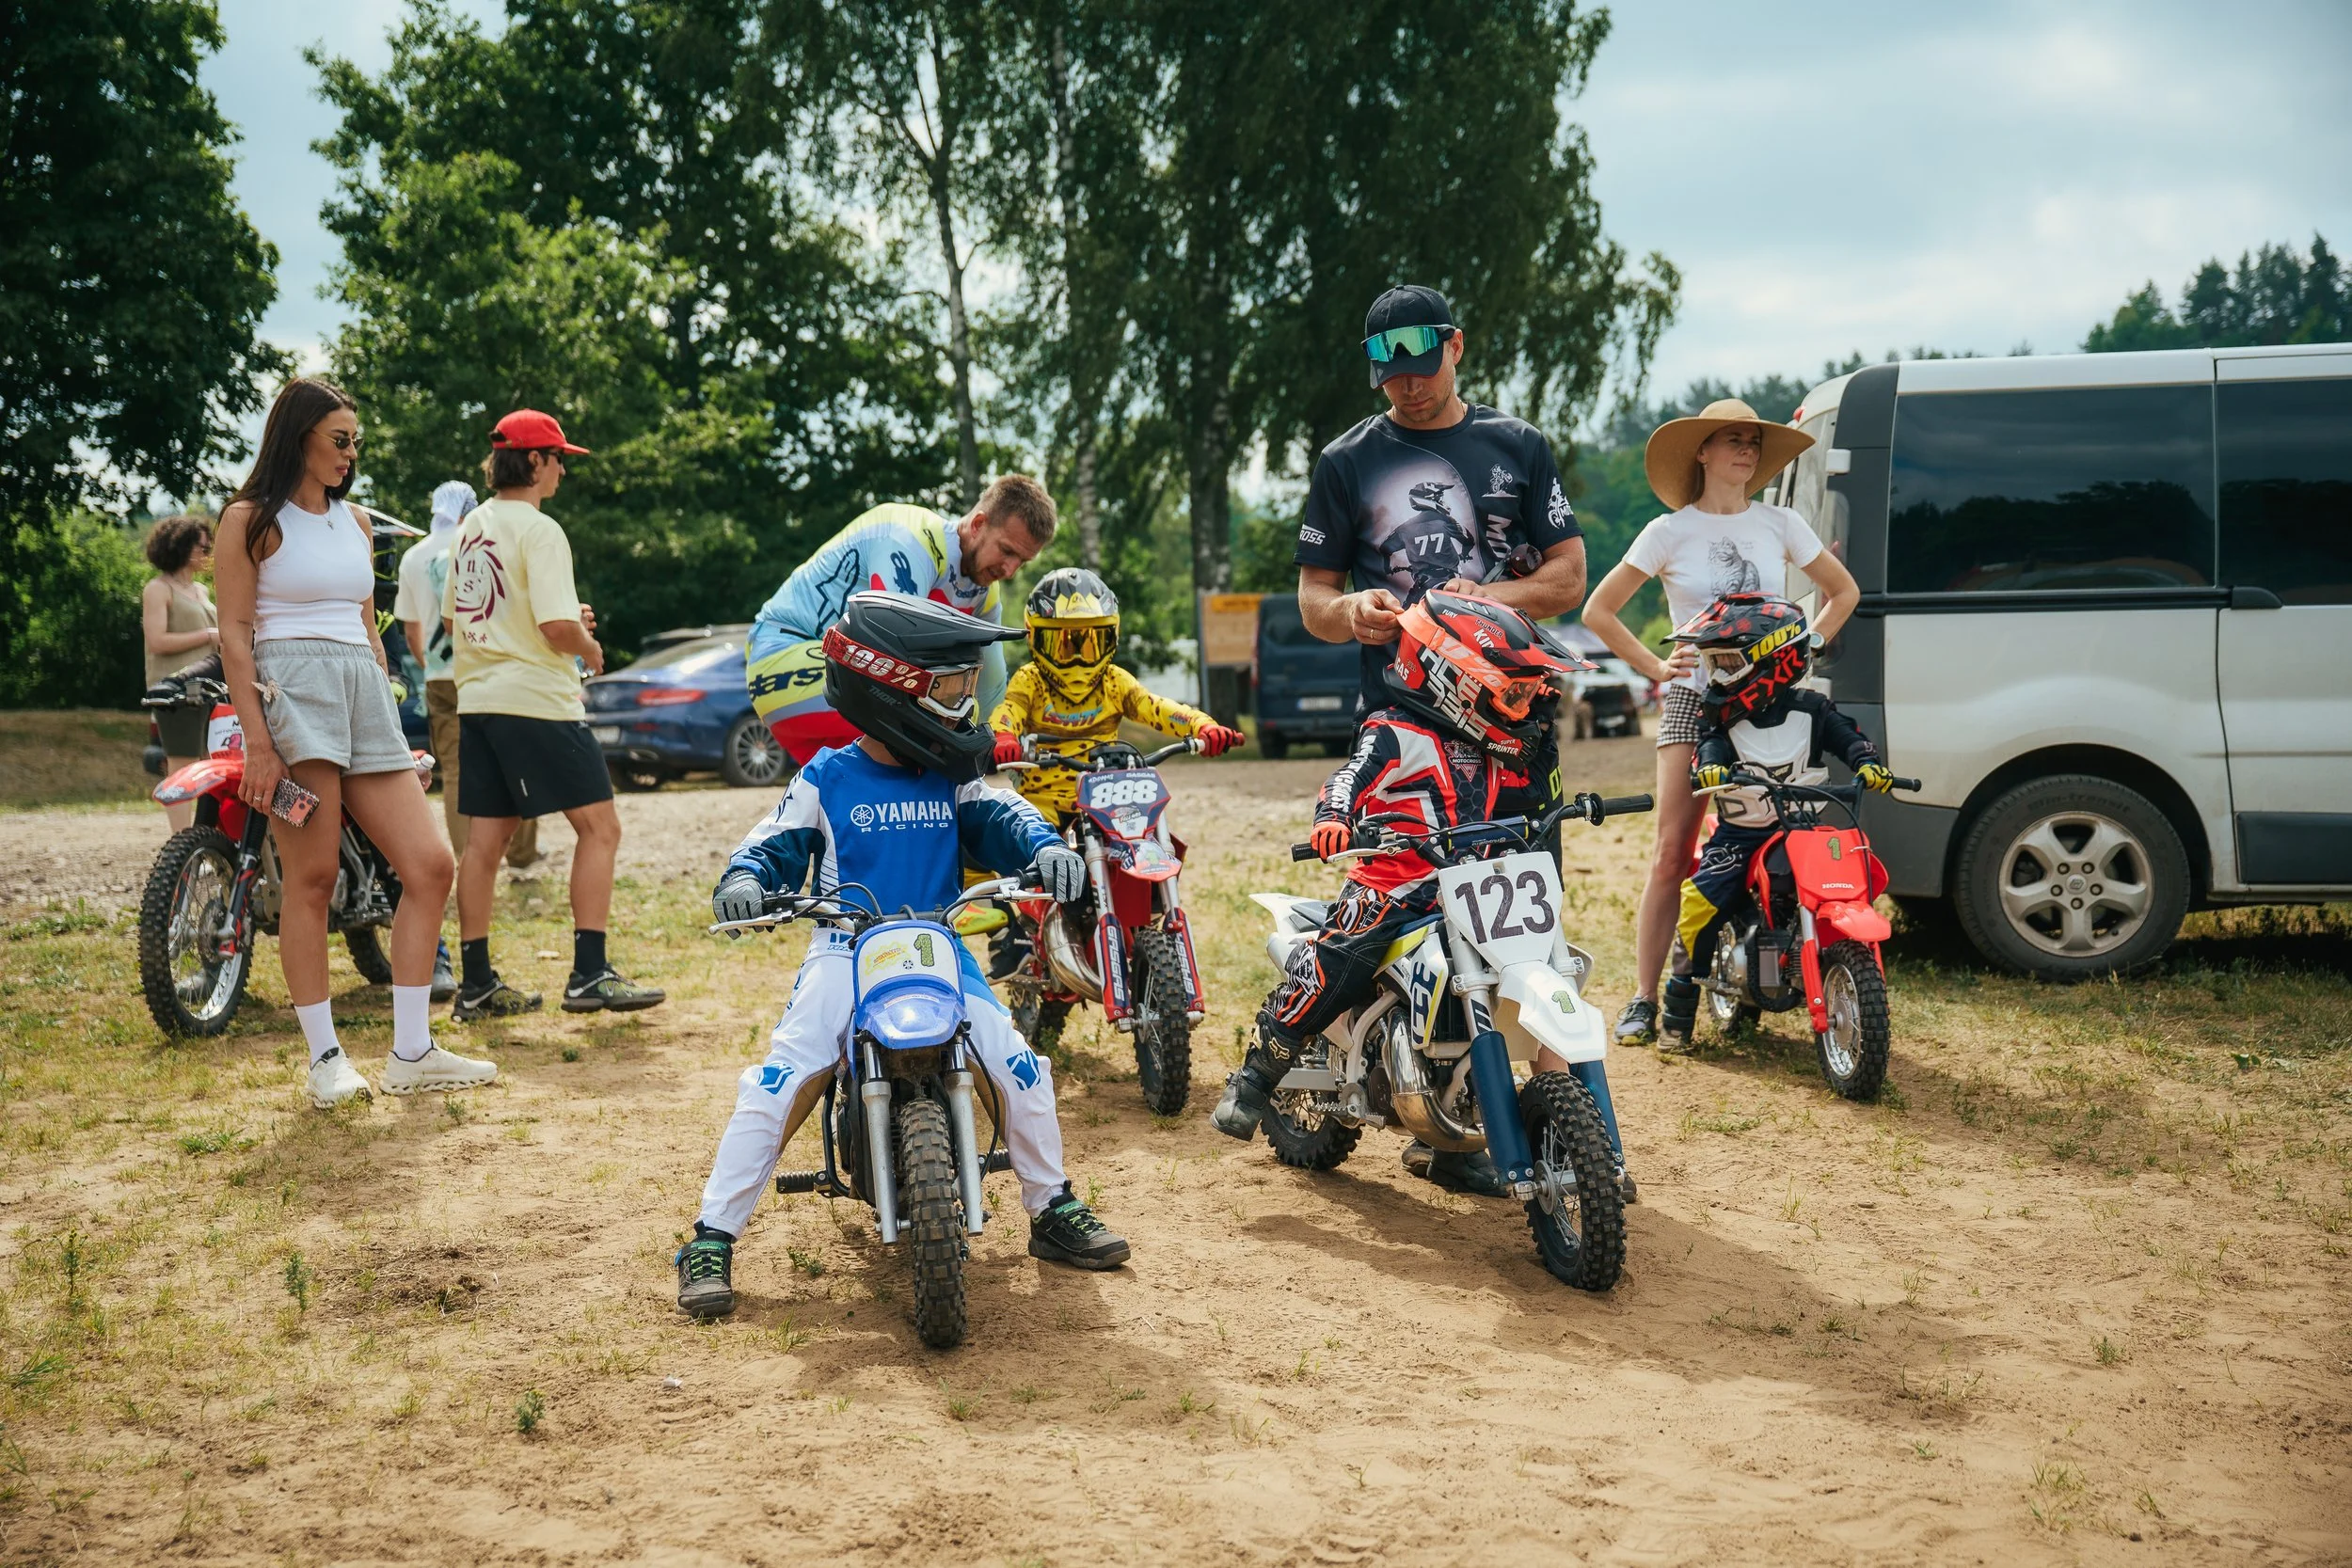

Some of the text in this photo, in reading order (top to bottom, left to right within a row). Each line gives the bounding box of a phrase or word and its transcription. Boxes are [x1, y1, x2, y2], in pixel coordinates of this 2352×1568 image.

[1414, 532, 1445, 556] 77
[1441, 609, 1458, 619] FURY
[1475, 619, 1503, 641] THUNDER
[1748, 623, 1802, 663] 100%
[841, 644, 922, 689] 100%
[1738, 647, 1805, 711] FXR
[868, 685, 898, 707] THOR
[1486, 742, 1519, 756] SPRINTER
[1089, 779, 1159, 809] 888
[874, 800, 954, 824] YAMAHA
[861, 822, 949, 833] RACING
[1827, 836, 1842, 861] 1
[1454, 870, 1555, 945] 123
[913, 933, 935, 967] 1
[1106, 925, 1126, 1002] GASGAS
[1175, 932, 1197, 995] ASGAS
[1552, 990, 1576, 1014] 1
